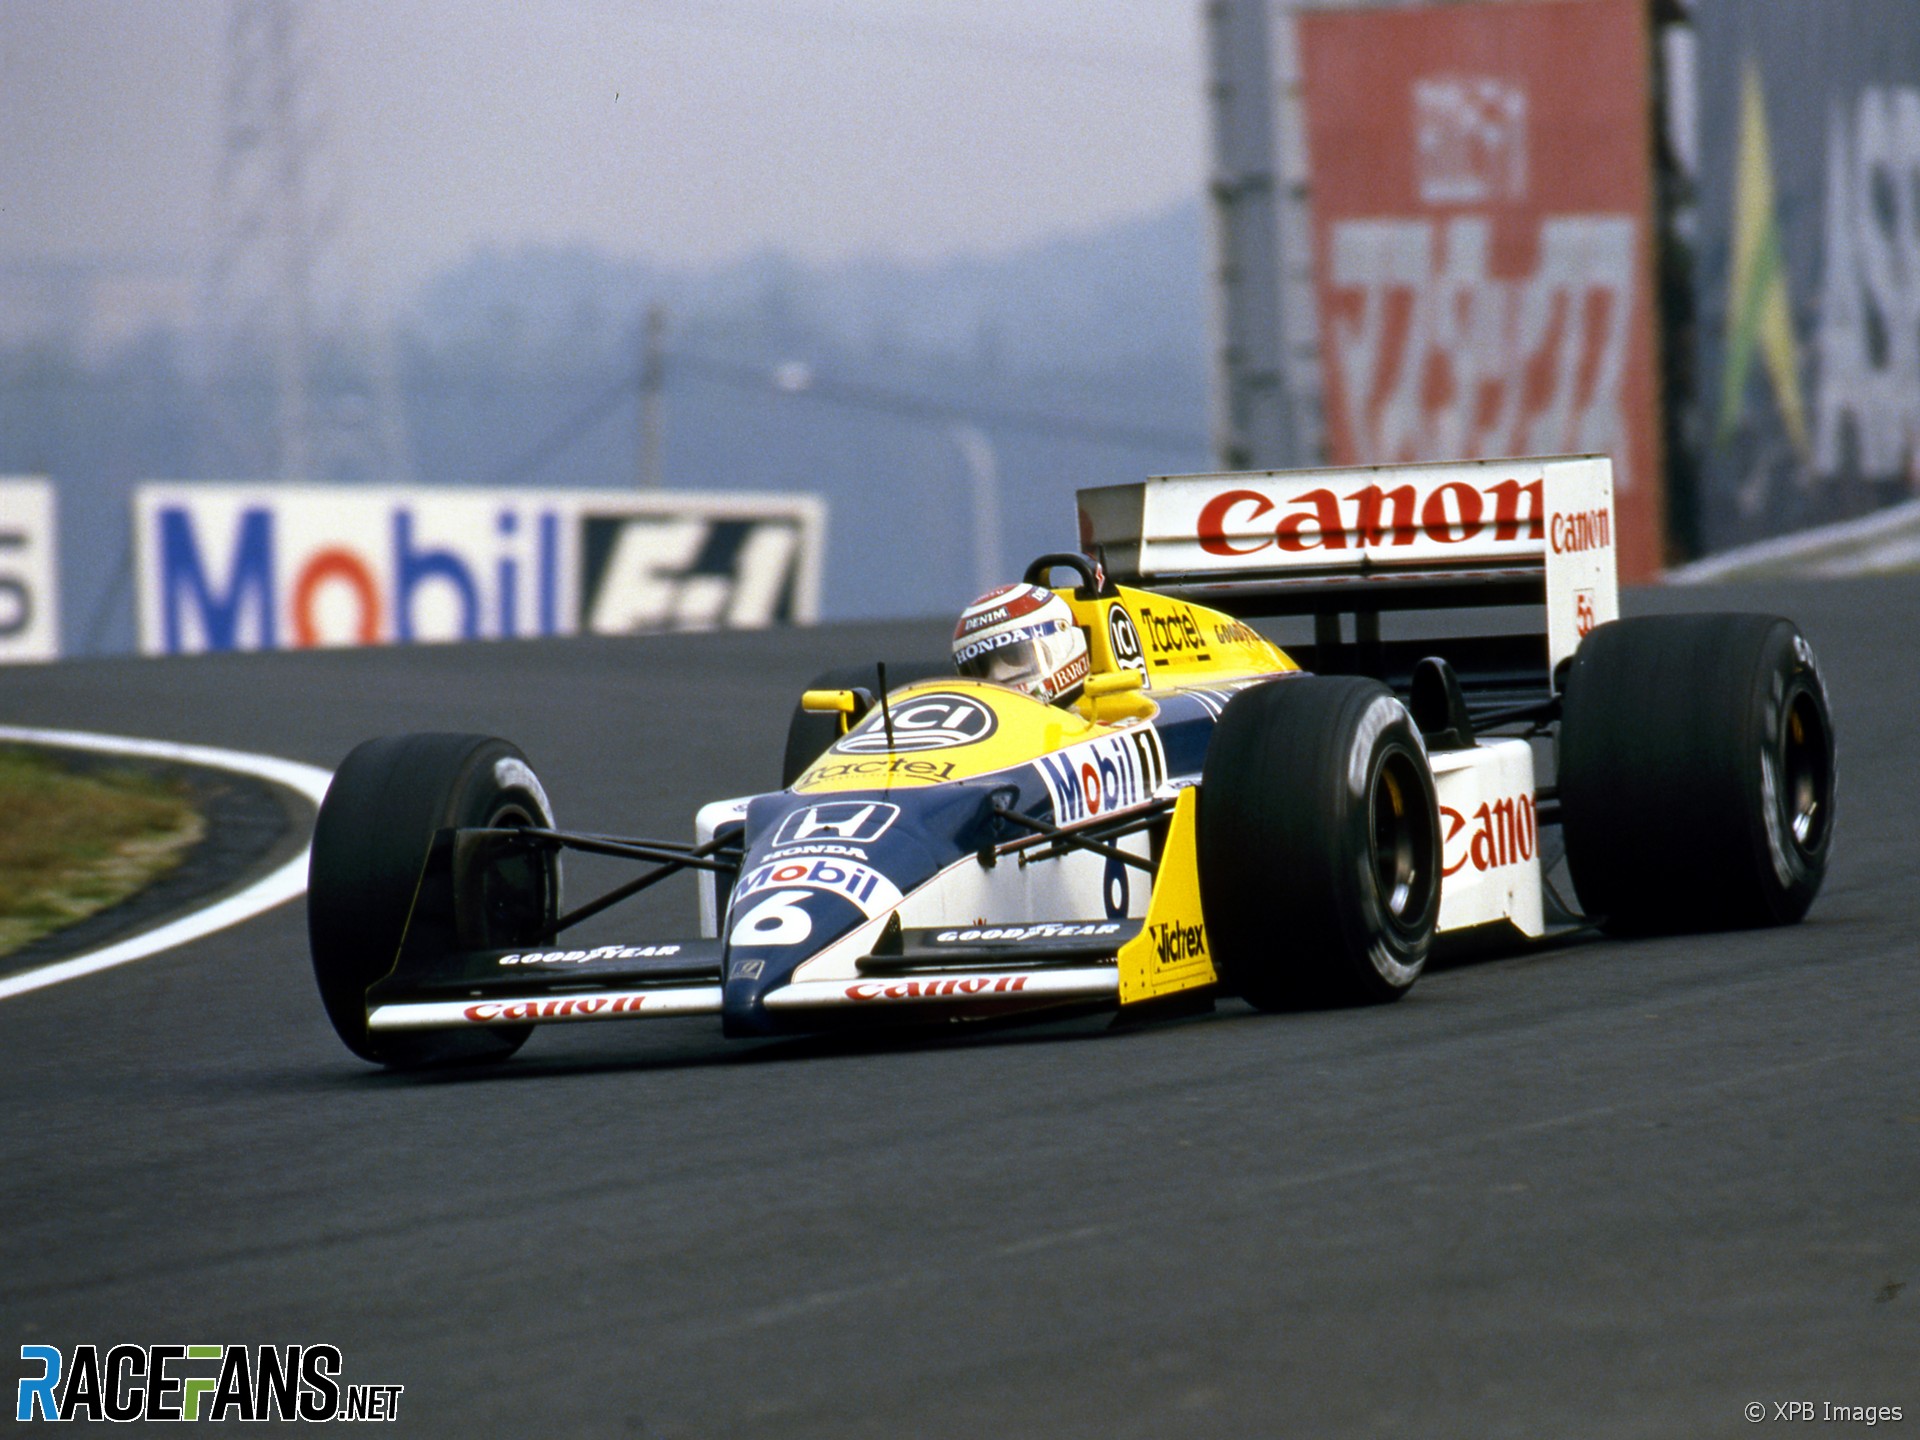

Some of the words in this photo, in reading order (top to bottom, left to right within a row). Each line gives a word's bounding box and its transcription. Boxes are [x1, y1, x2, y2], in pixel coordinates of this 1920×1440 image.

[1196, 478, 1544, 556] Canon
[1551, 507, 1610, 555] Canon
[157, 506, 559, 655] Mobil
[964, 606, 1009, 631] DENIM
[1140, 605, 1206, 652] Tactel
[955, 628, 1030, 664] HONDA
[1112, 619, 1138, 656] ICI
[866, 704, 976, 733] ICI
[1040, 735, 1137, 823] Mobil
[1138, 732, 1157, 794] 1
[760, 844, 869, 864] HONDA
[735, 860, 880, 904] Mobil
[730, 889, 815, 947] 6
[936, 922, 1121, 942] GOODYEAR
[498, 944, 681, 965] GOODYEAR
[1149, 919, 1205, 964] Victrex
[844, 975, 1029, 1001] Canon
[463, 996, 646, 1022] Canon
